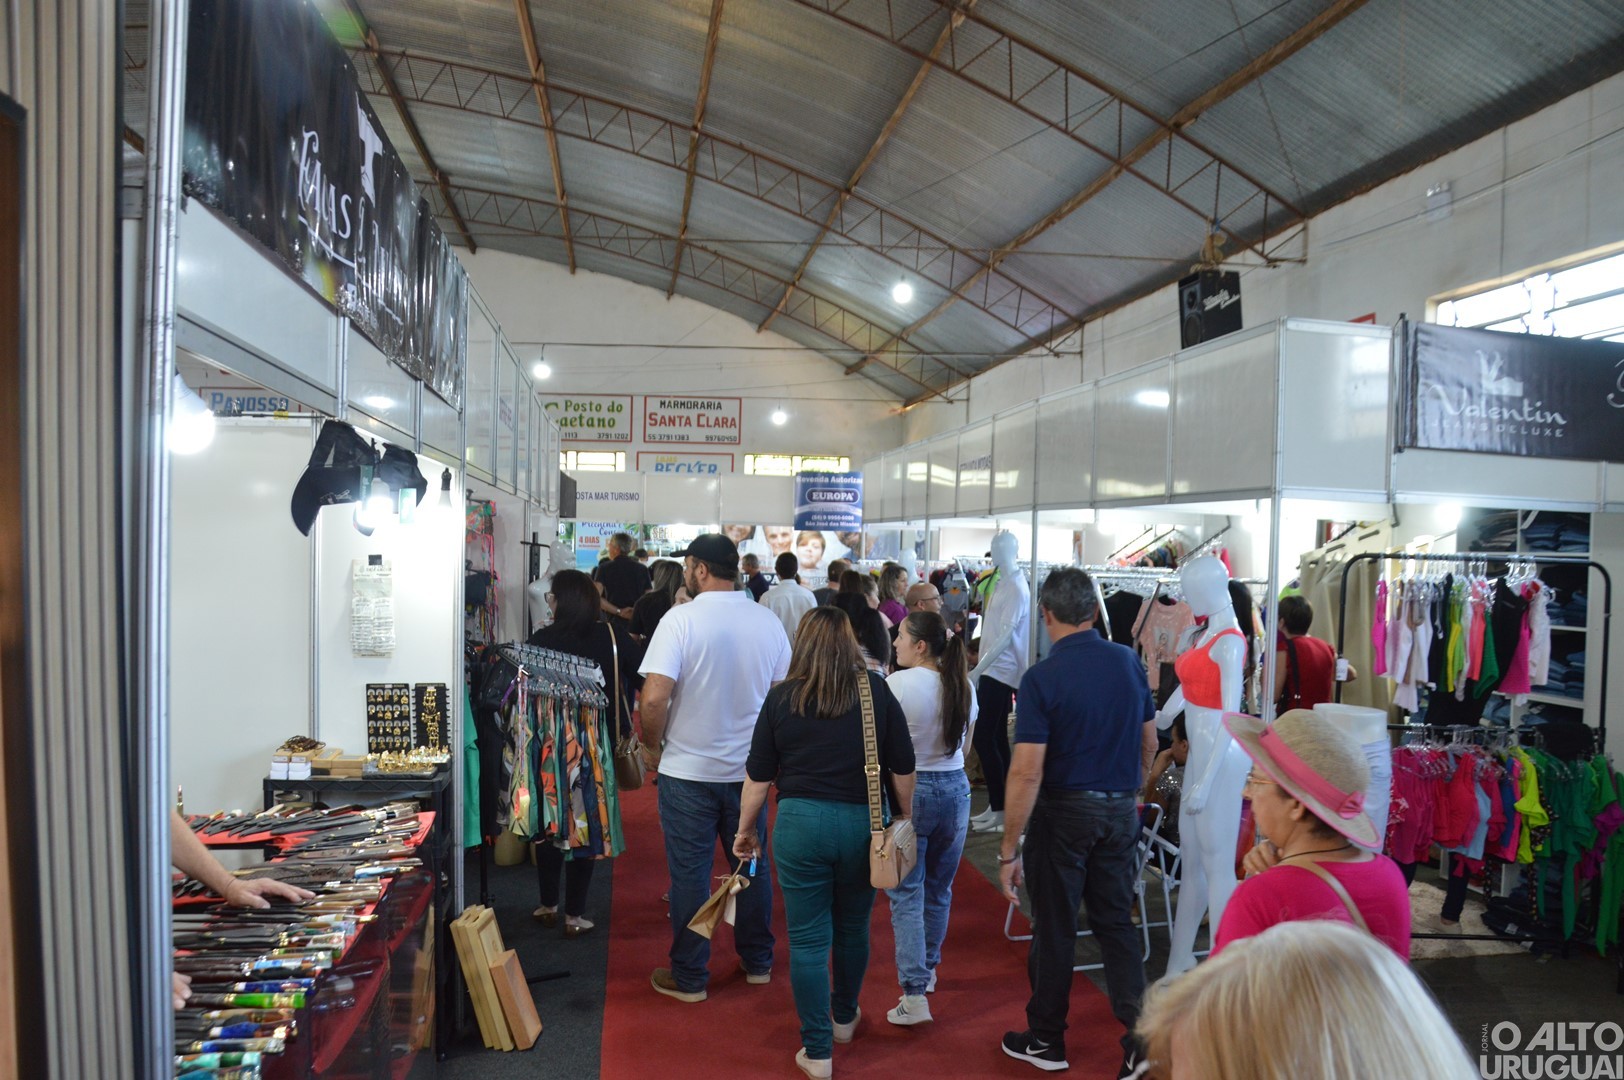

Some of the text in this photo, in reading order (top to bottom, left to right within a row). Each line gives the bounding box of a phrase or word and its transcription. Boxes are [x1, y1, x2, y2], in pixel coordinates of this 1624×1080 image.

[211, 392, 288, 412] PANOSSO
[564, 399, 623, 413] Posto do
[659, 399, 722, 410] MARMORARIA
[1427, 384, 1567, 425] Valentin
[551, 406, 616, 429] aetano
[648, 412, 737, 429] SANTA CLARA
[1496, 425, 1564, 438] DELUXE
[594, 492, 609, 501] MAR
[610, 492, 640, 501] TURISMO
[812, 491, 854, 501] EUROPA
[578, 536, 600, 544] 4 DIAS
